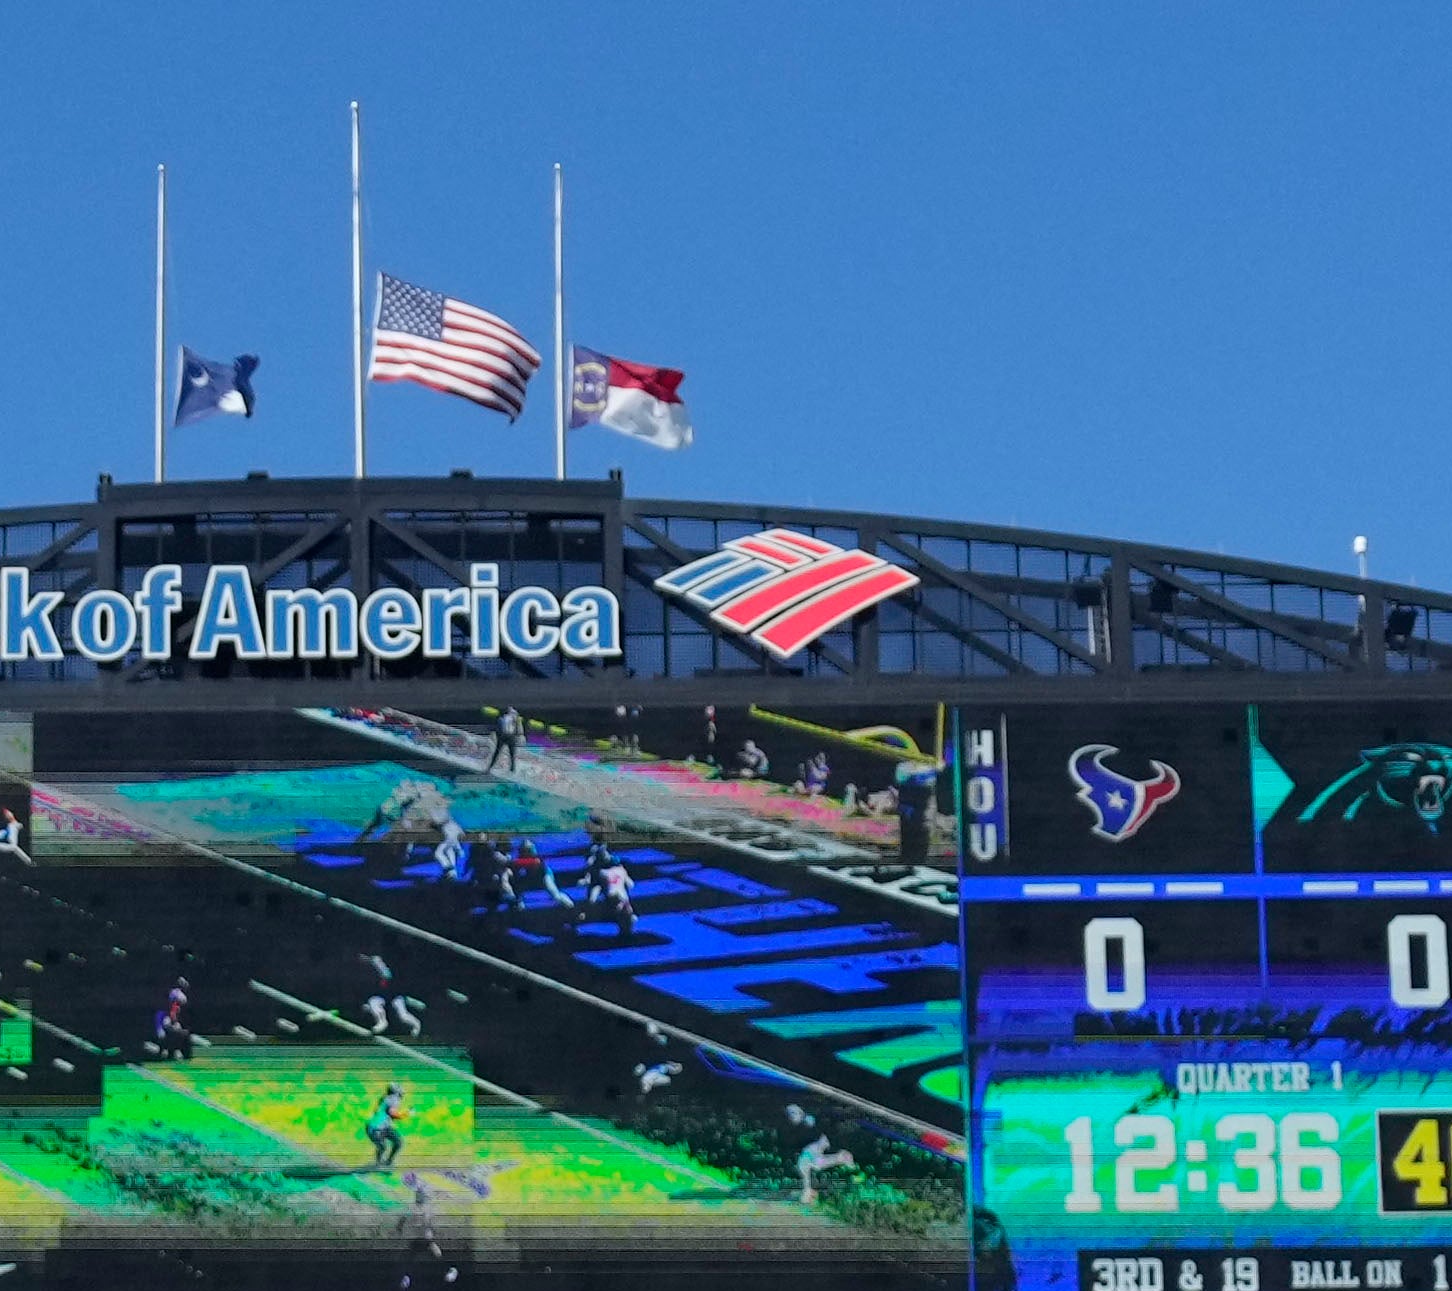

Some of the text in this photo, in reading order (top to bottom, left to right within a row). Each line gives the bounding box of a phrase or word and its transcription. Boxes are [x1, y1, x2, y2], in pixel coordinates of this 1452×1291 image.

[69, 564, 182, 661] of
[188, 564, 622, 660] America
[969, 730, 997, 861] HOU
[1084, 917, 1147, 1010] 0
[1388, 914, 1450, 1008] 0
[1176, 1062, 1344, 1095] QUARTER 1
[1063, 1111, 1344, 1214] 12:36
[1179, 1260, 1204, 1291] &
[1291, 1259, 1360, 1290] BALL
[1366, 1258, 1403, 1289] ON
[1432, 1254, 1450, 1291] 1
